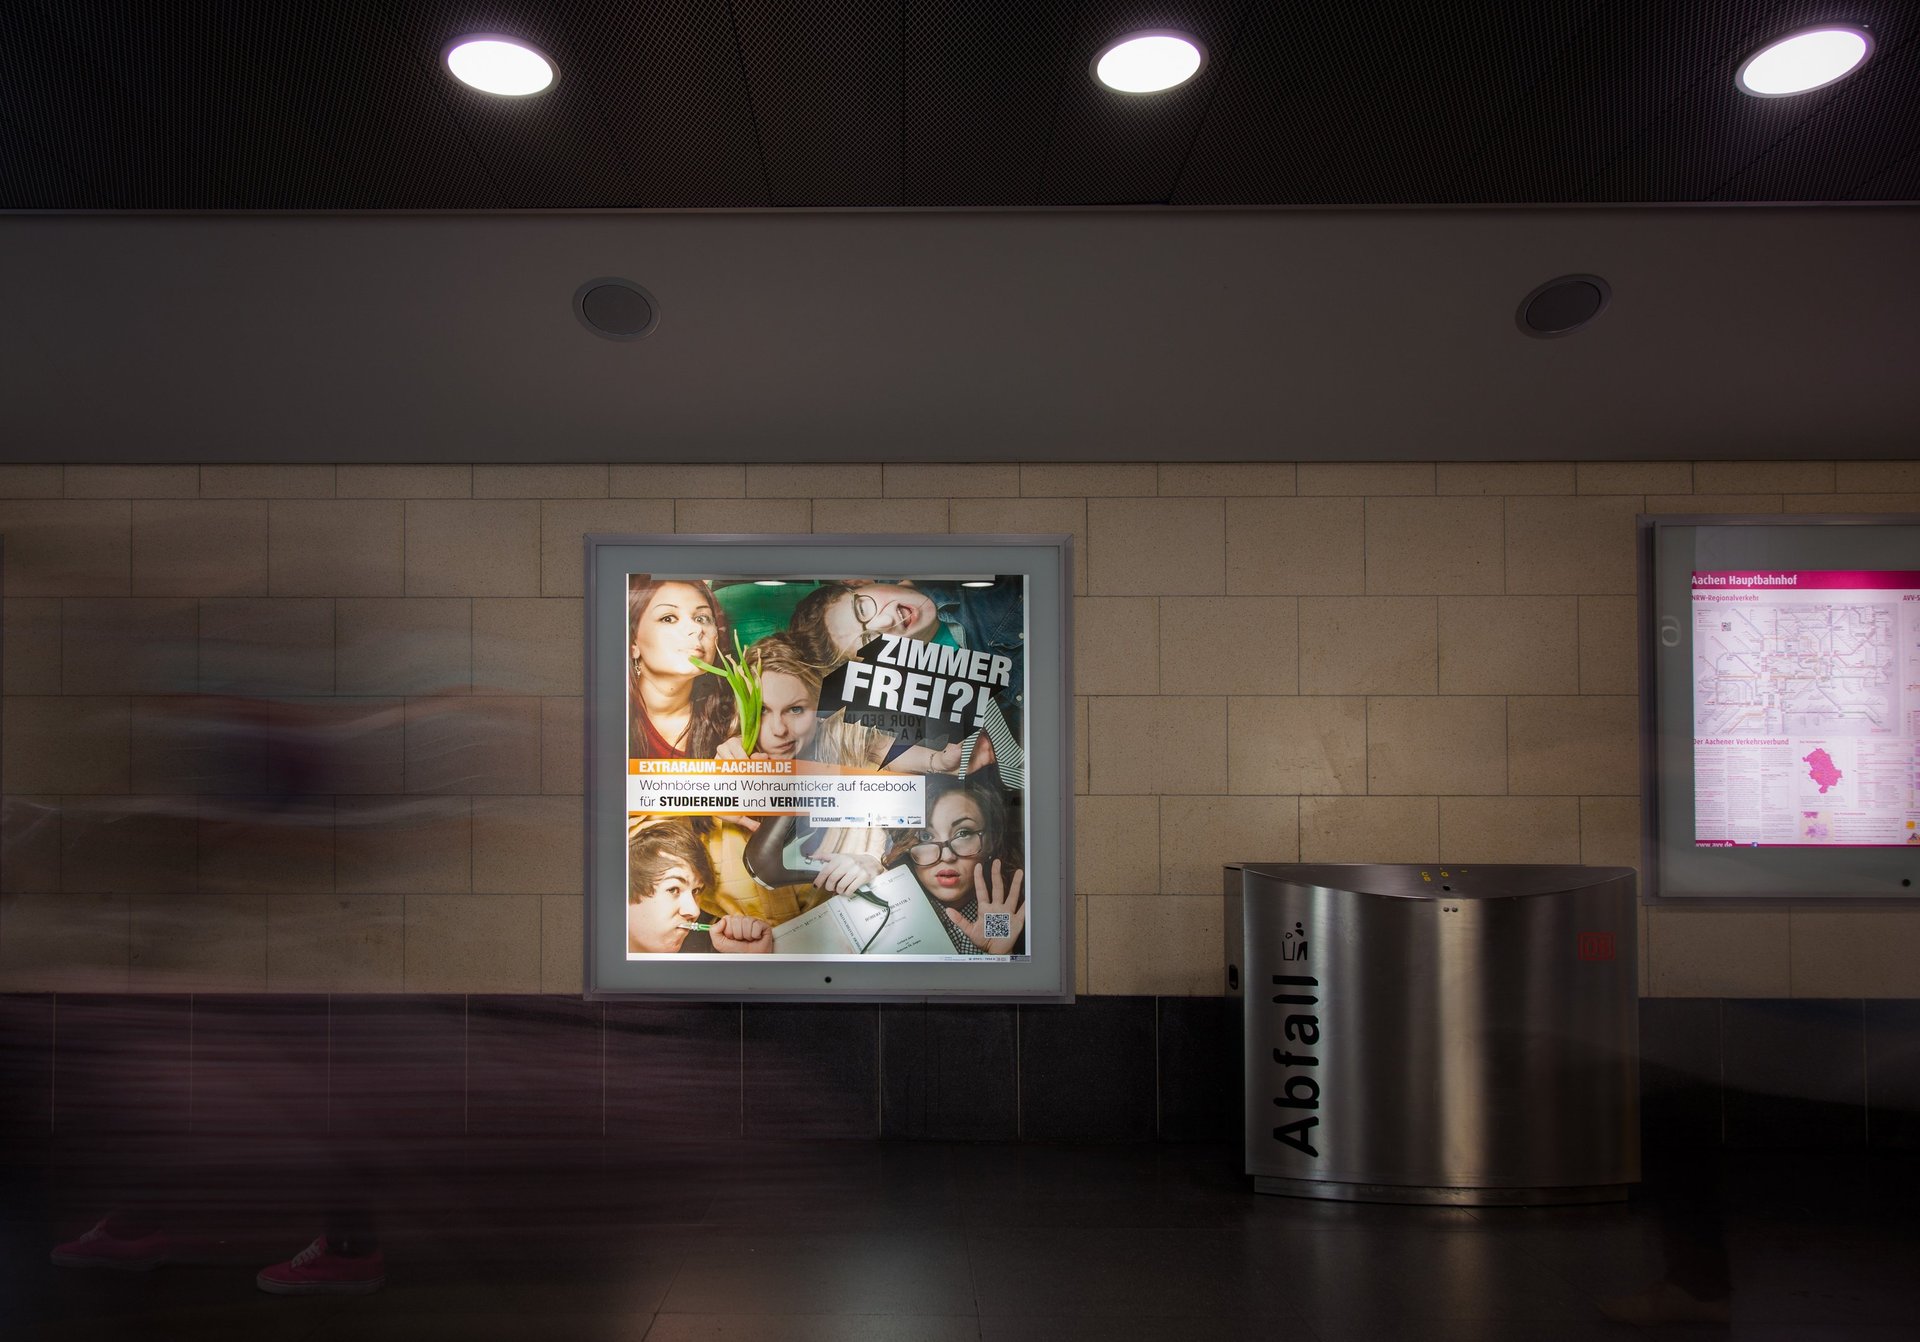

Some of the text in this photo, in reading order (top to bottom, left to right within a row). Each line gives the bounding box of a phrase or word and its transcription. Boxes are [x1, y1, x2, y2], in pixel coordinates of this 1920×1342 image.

[1691, 574, 1798, 588] Aachen Hauptbahnhof
[877, 633, 1013, 687] ZIMMER
[841, 660, 992, 728] FREI?!
[639, 761, 792, 773] EXTRARAUM-AACHEN.DE
[639, 779, 917, 792] Wohnbörse und Wohraumticker auf facebook
[640, 796, 839, 808] für STUDIERENDE und VERMIETER.
[1273, 974, 1319, 1158] Abfall
